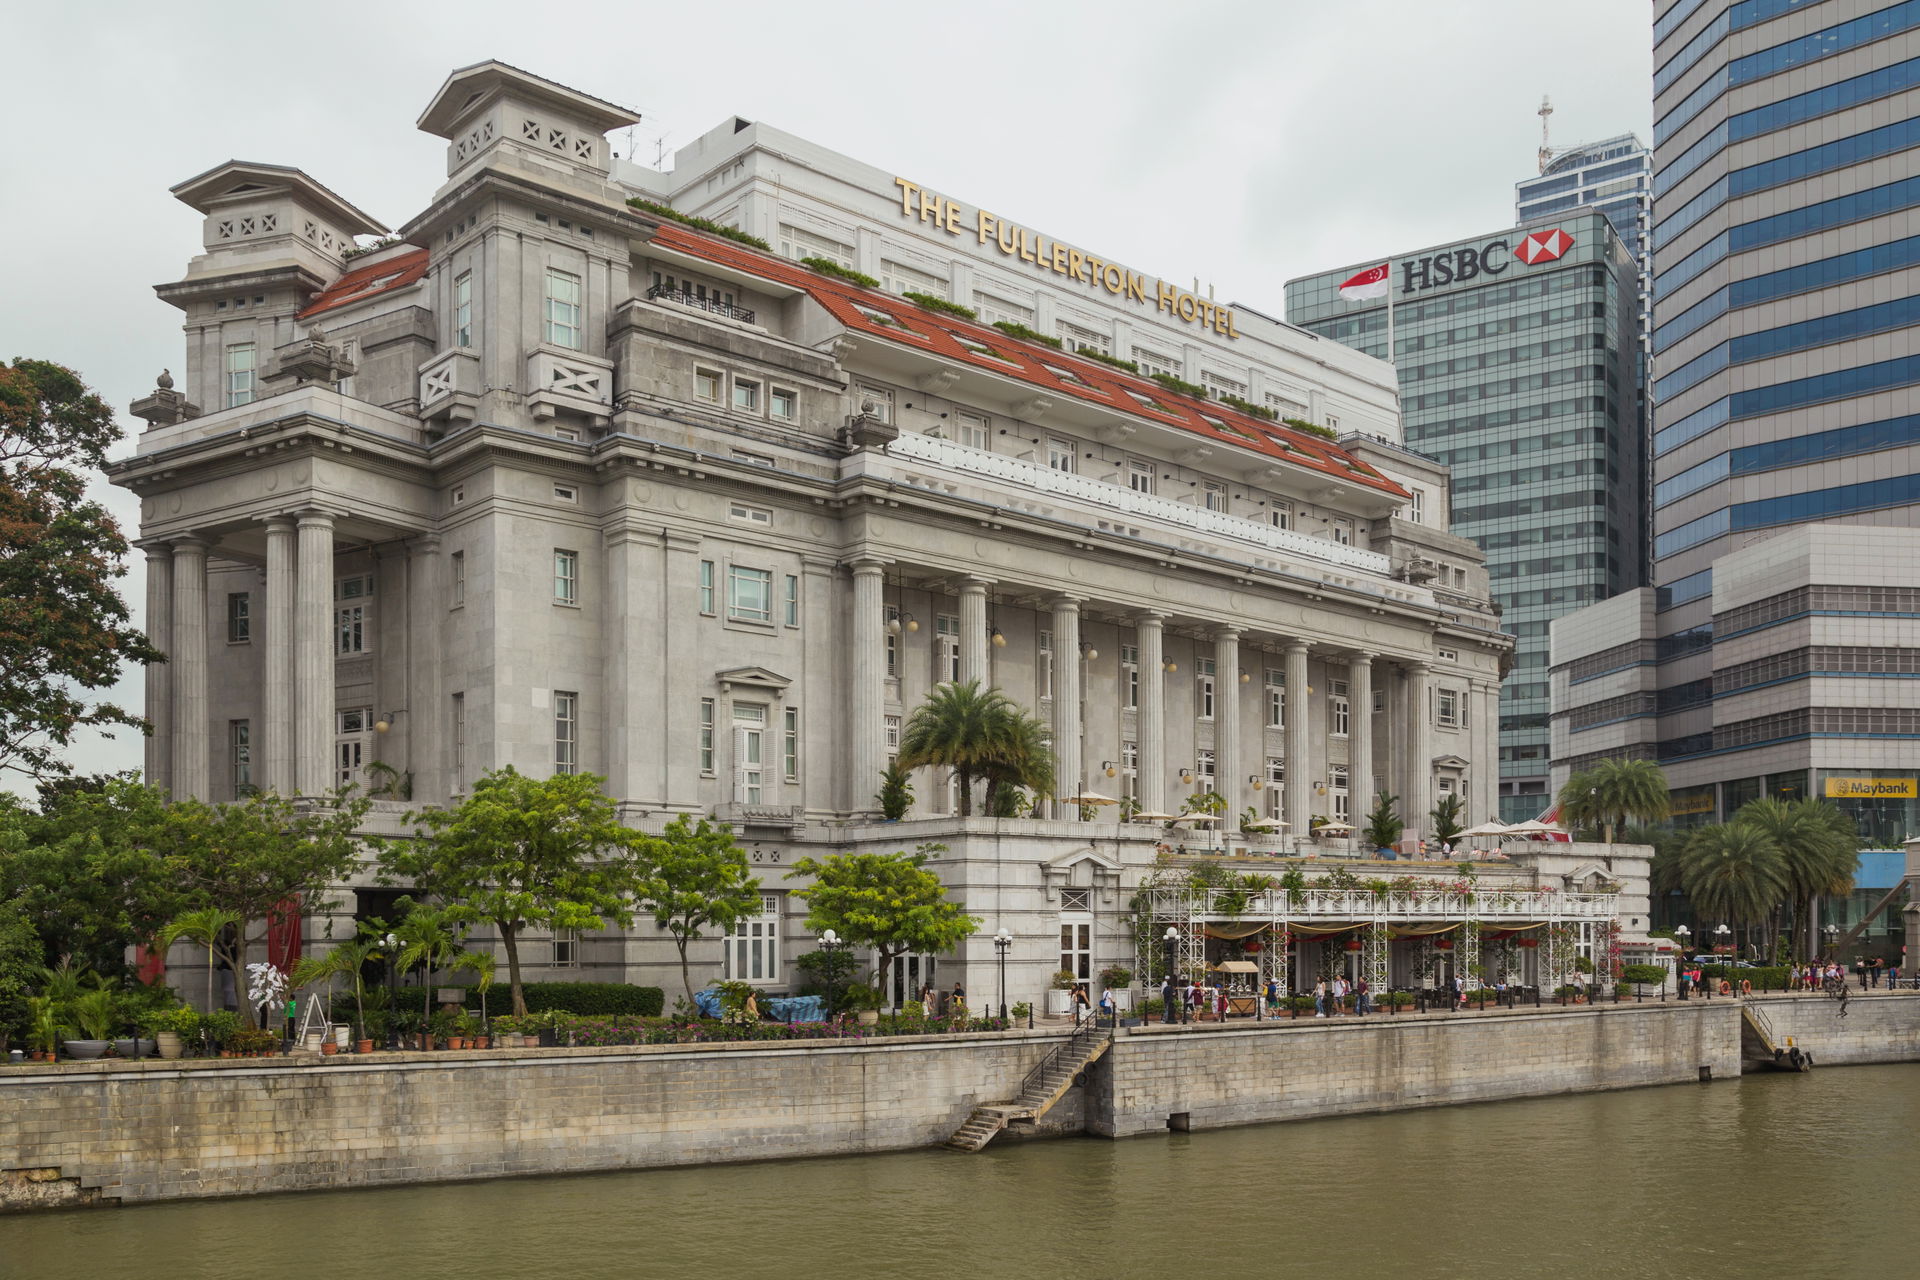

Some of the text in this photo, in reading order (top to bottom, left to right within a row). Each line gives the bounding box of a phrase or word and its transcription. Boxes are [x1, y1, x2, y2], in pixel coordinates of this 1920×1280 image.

[895, 176, 1240, 339] THE FULLERTON HOTEL
[1401, 239, 1509, 293] HSBC
[1850, 782, 1909, 796] Maybank
